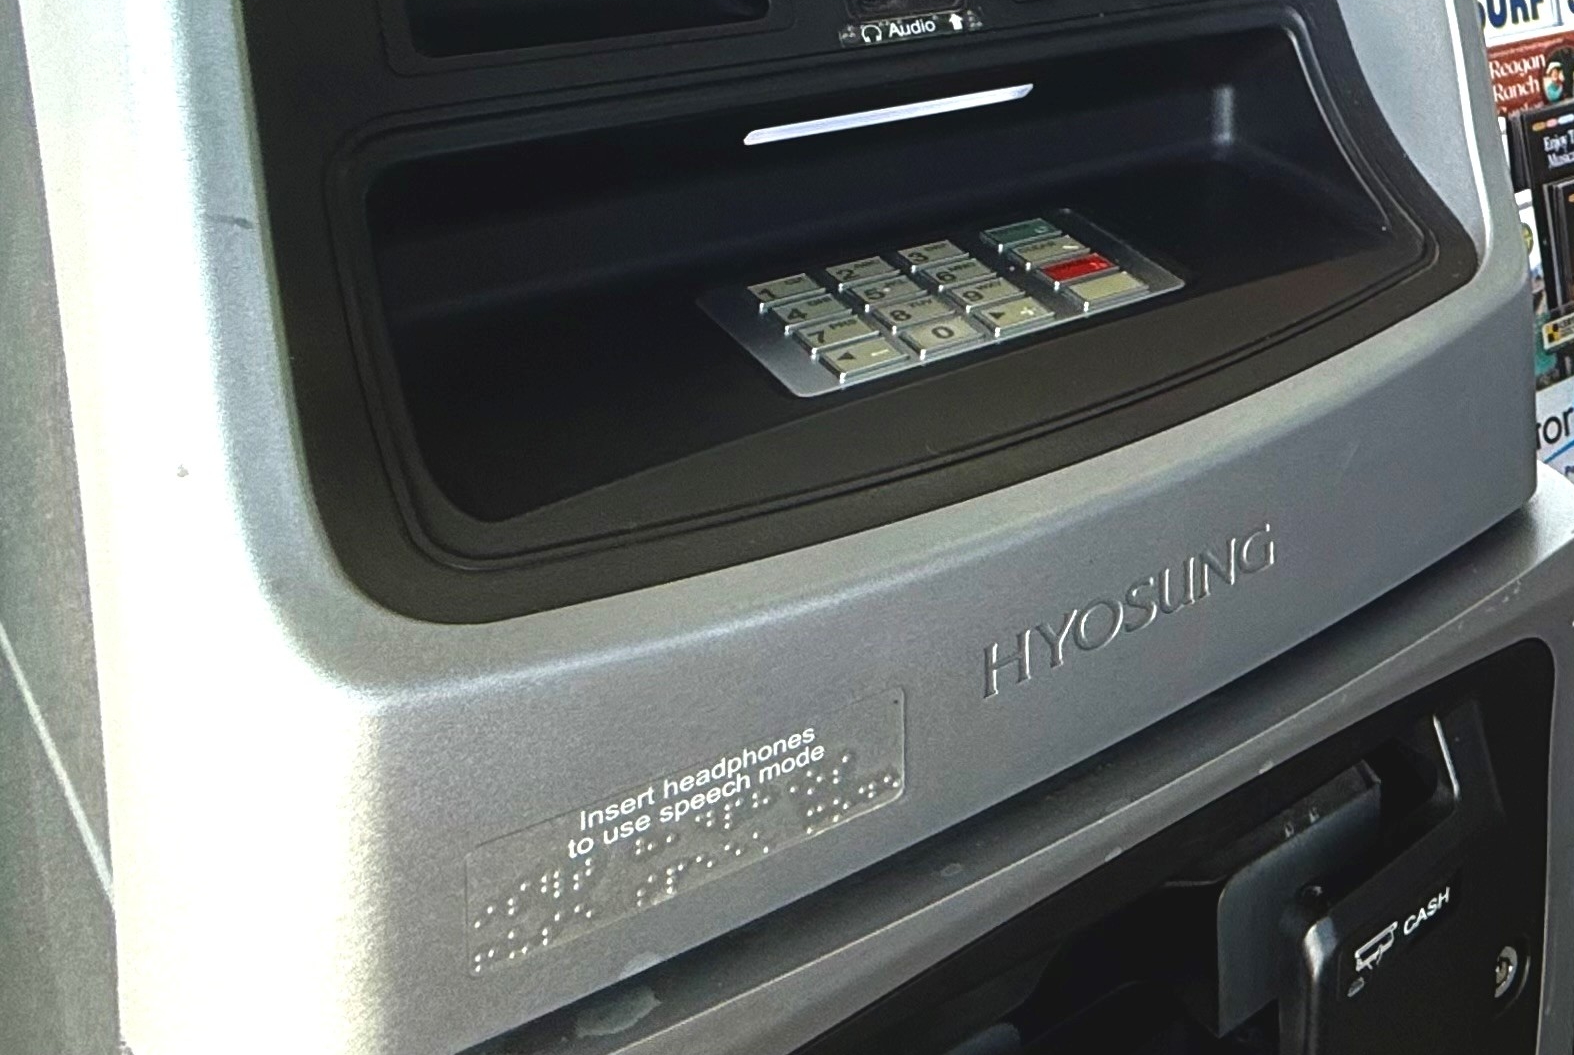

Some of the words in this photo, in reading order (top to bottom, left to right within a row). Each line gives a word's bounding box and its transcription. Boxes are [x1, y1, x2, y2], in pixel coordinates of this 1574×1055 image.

[888, 18, 937, 38] Audio
[1489, 53, 1546, 80] Reagan
[1492, 74, 1540, 102] Ranch
[1543, 133, 1568, 153] Enjoy
[908, 251, 929, 263] 3
[835, 268, 855, 281] 2
[936, 271, 956, 283] 6
[962, 290, 984, 302] 9
[787, 307, 808, 321] 4
[889, 309, 912, 322] 8
[807, 330, 826, 344] 7
[931, 325, 955, 340] 0
[983, 521, 1275, 699] HYOSUNG
[580, 785, 656, 831] Insert
[663, 727, 816, 800] headphones
[568, 837, 594, 859] to
[603, 816, 651, 844] use
[659, 775, 751, 826] speech
[758, 744, 826, 781] mode
[1403, 885, 1451, 936] CASH
